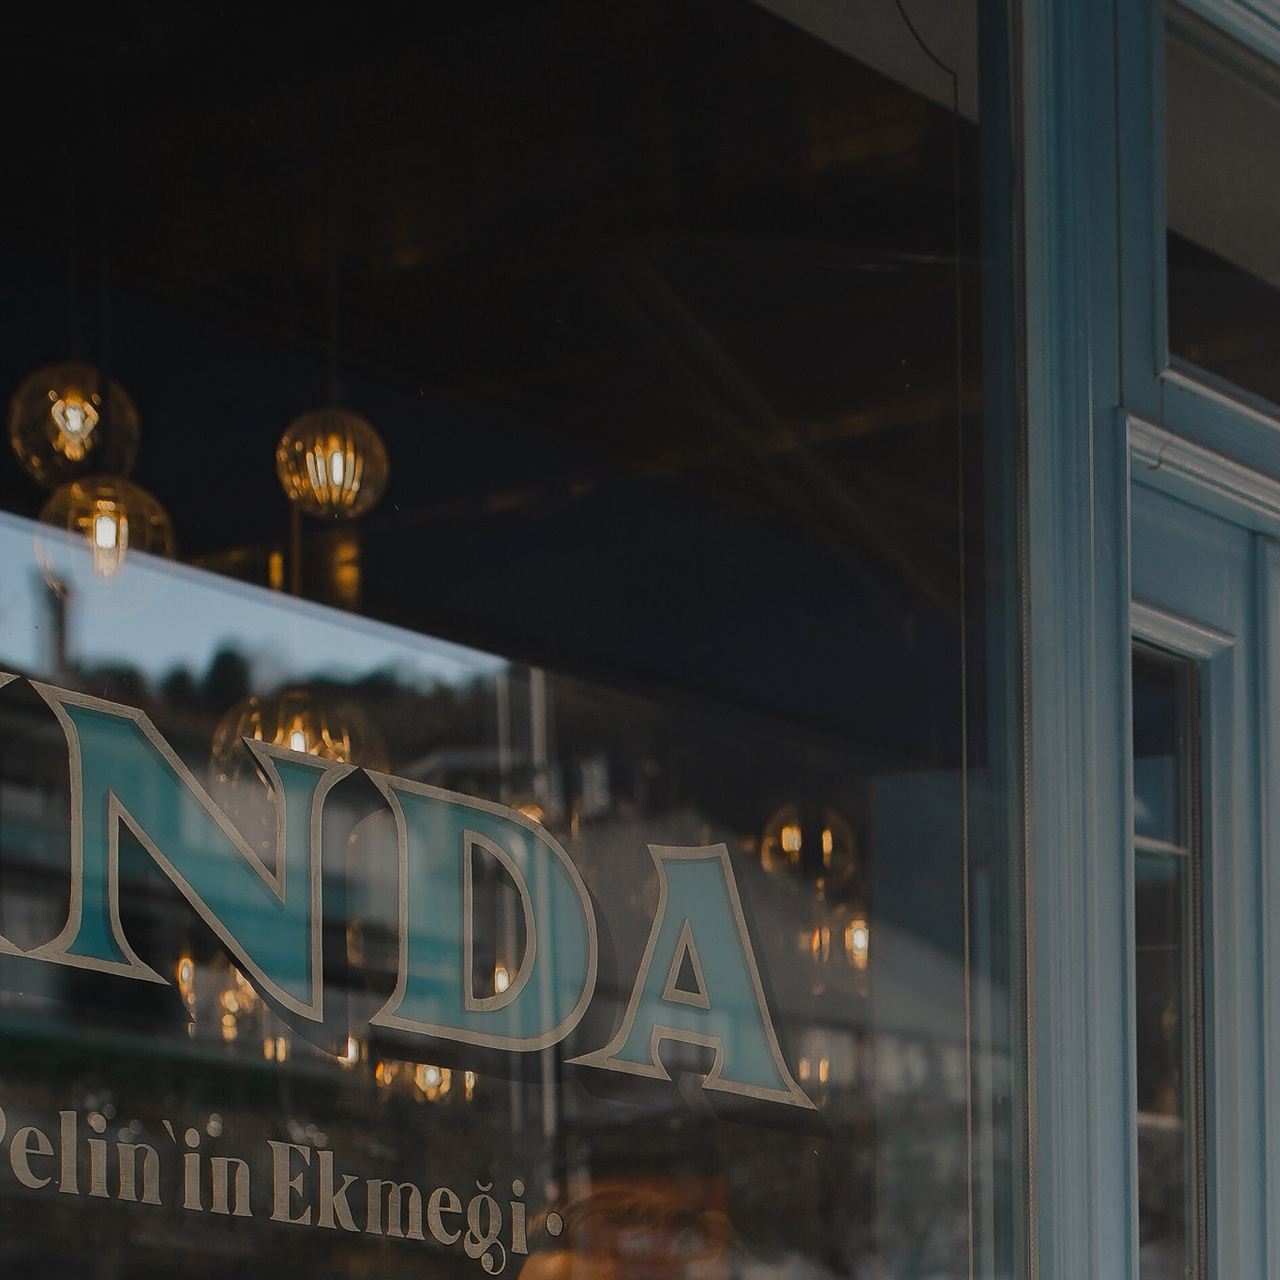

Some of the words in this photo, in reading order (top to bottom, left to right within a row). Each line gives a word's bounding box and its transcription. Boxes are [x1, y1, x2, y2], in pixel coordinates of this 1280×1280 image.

[0, 671, 819, 1110] NDA
[0, 1106, 253, 1218] elin'in
[266, 1139, 529, 1275] Ekmeği
